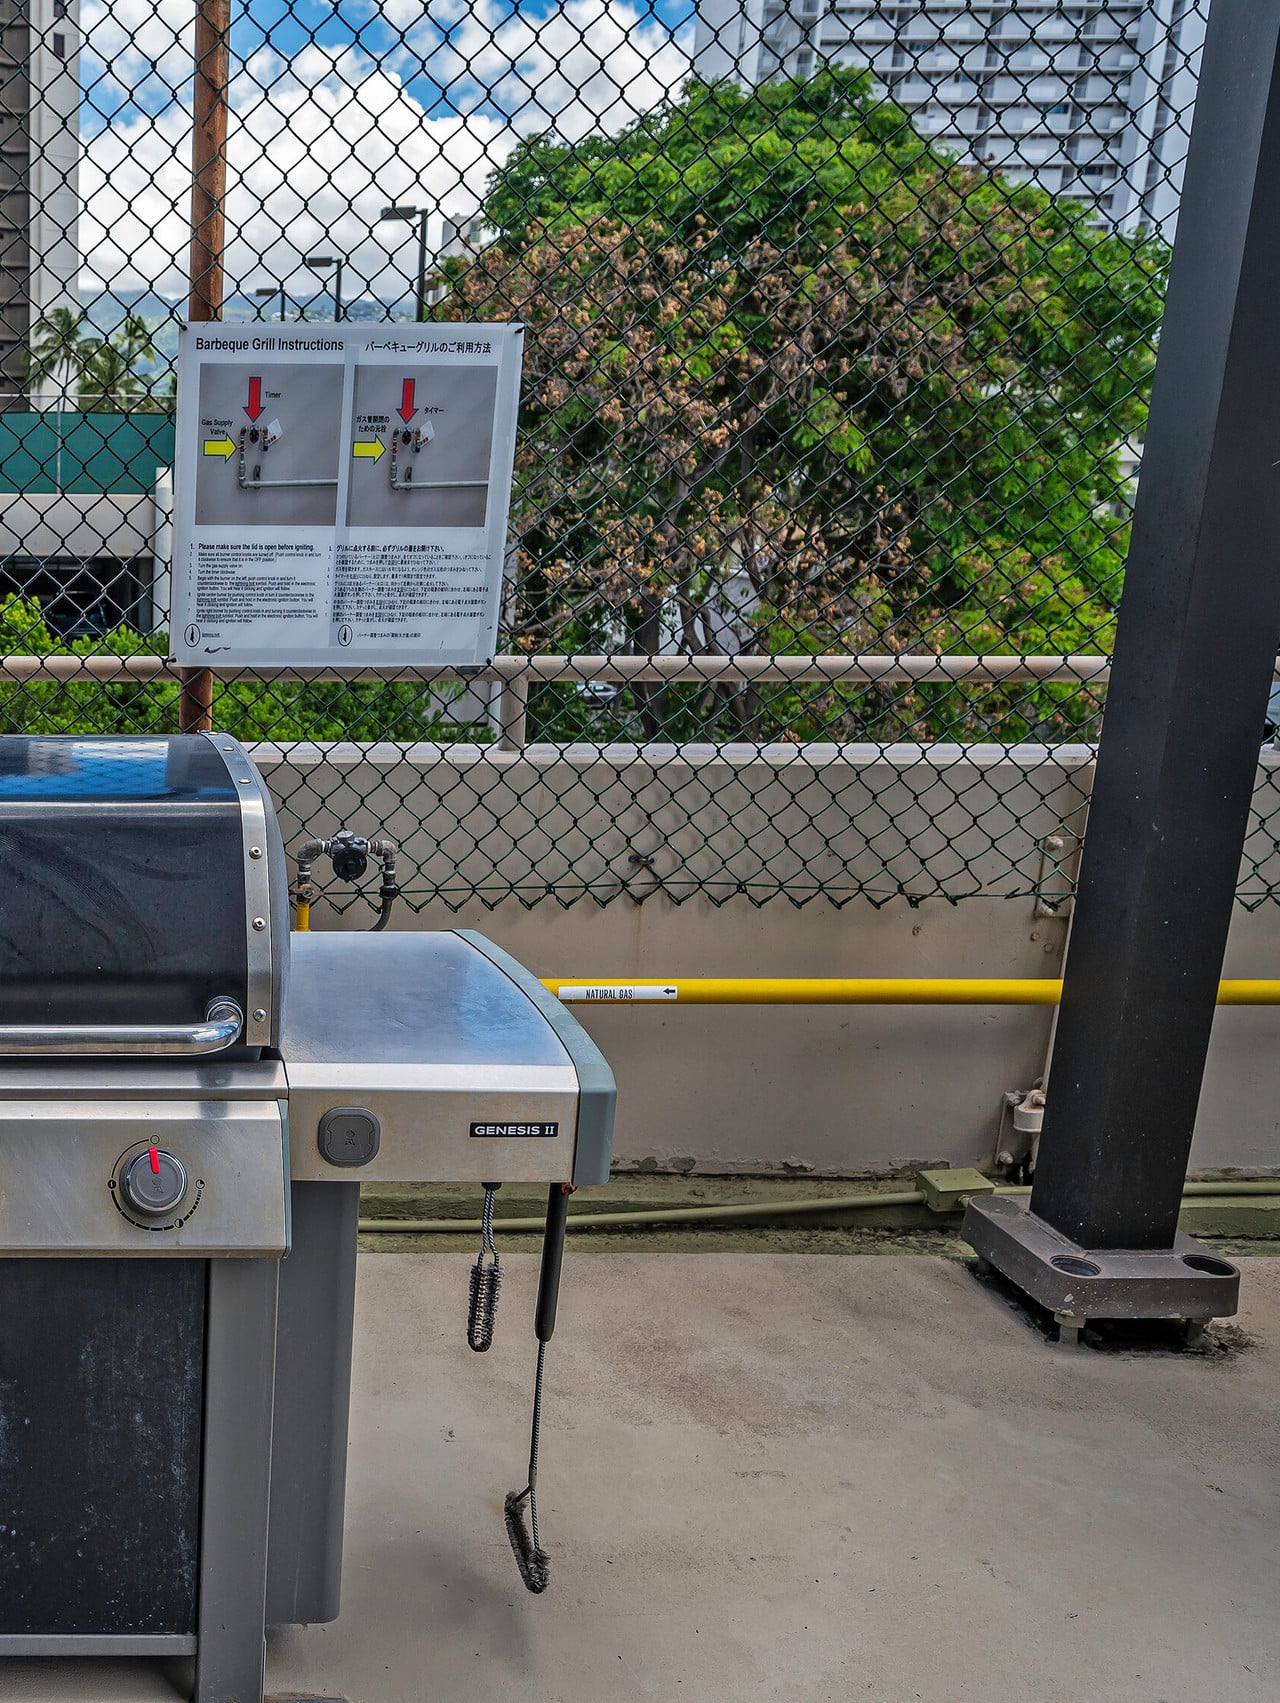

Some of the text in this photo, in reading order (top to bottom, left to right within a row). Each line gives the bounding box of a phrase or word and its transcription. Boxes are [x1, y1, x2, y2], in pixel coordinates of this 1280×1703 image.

[196, 338, 344, 353] Barbeque Grill Instructions
[213, 419, 233, 427] Supply
[586, 989, 633, 999] NATURAL GAS
[475, 1126, 554, 1135] GENESIS II
